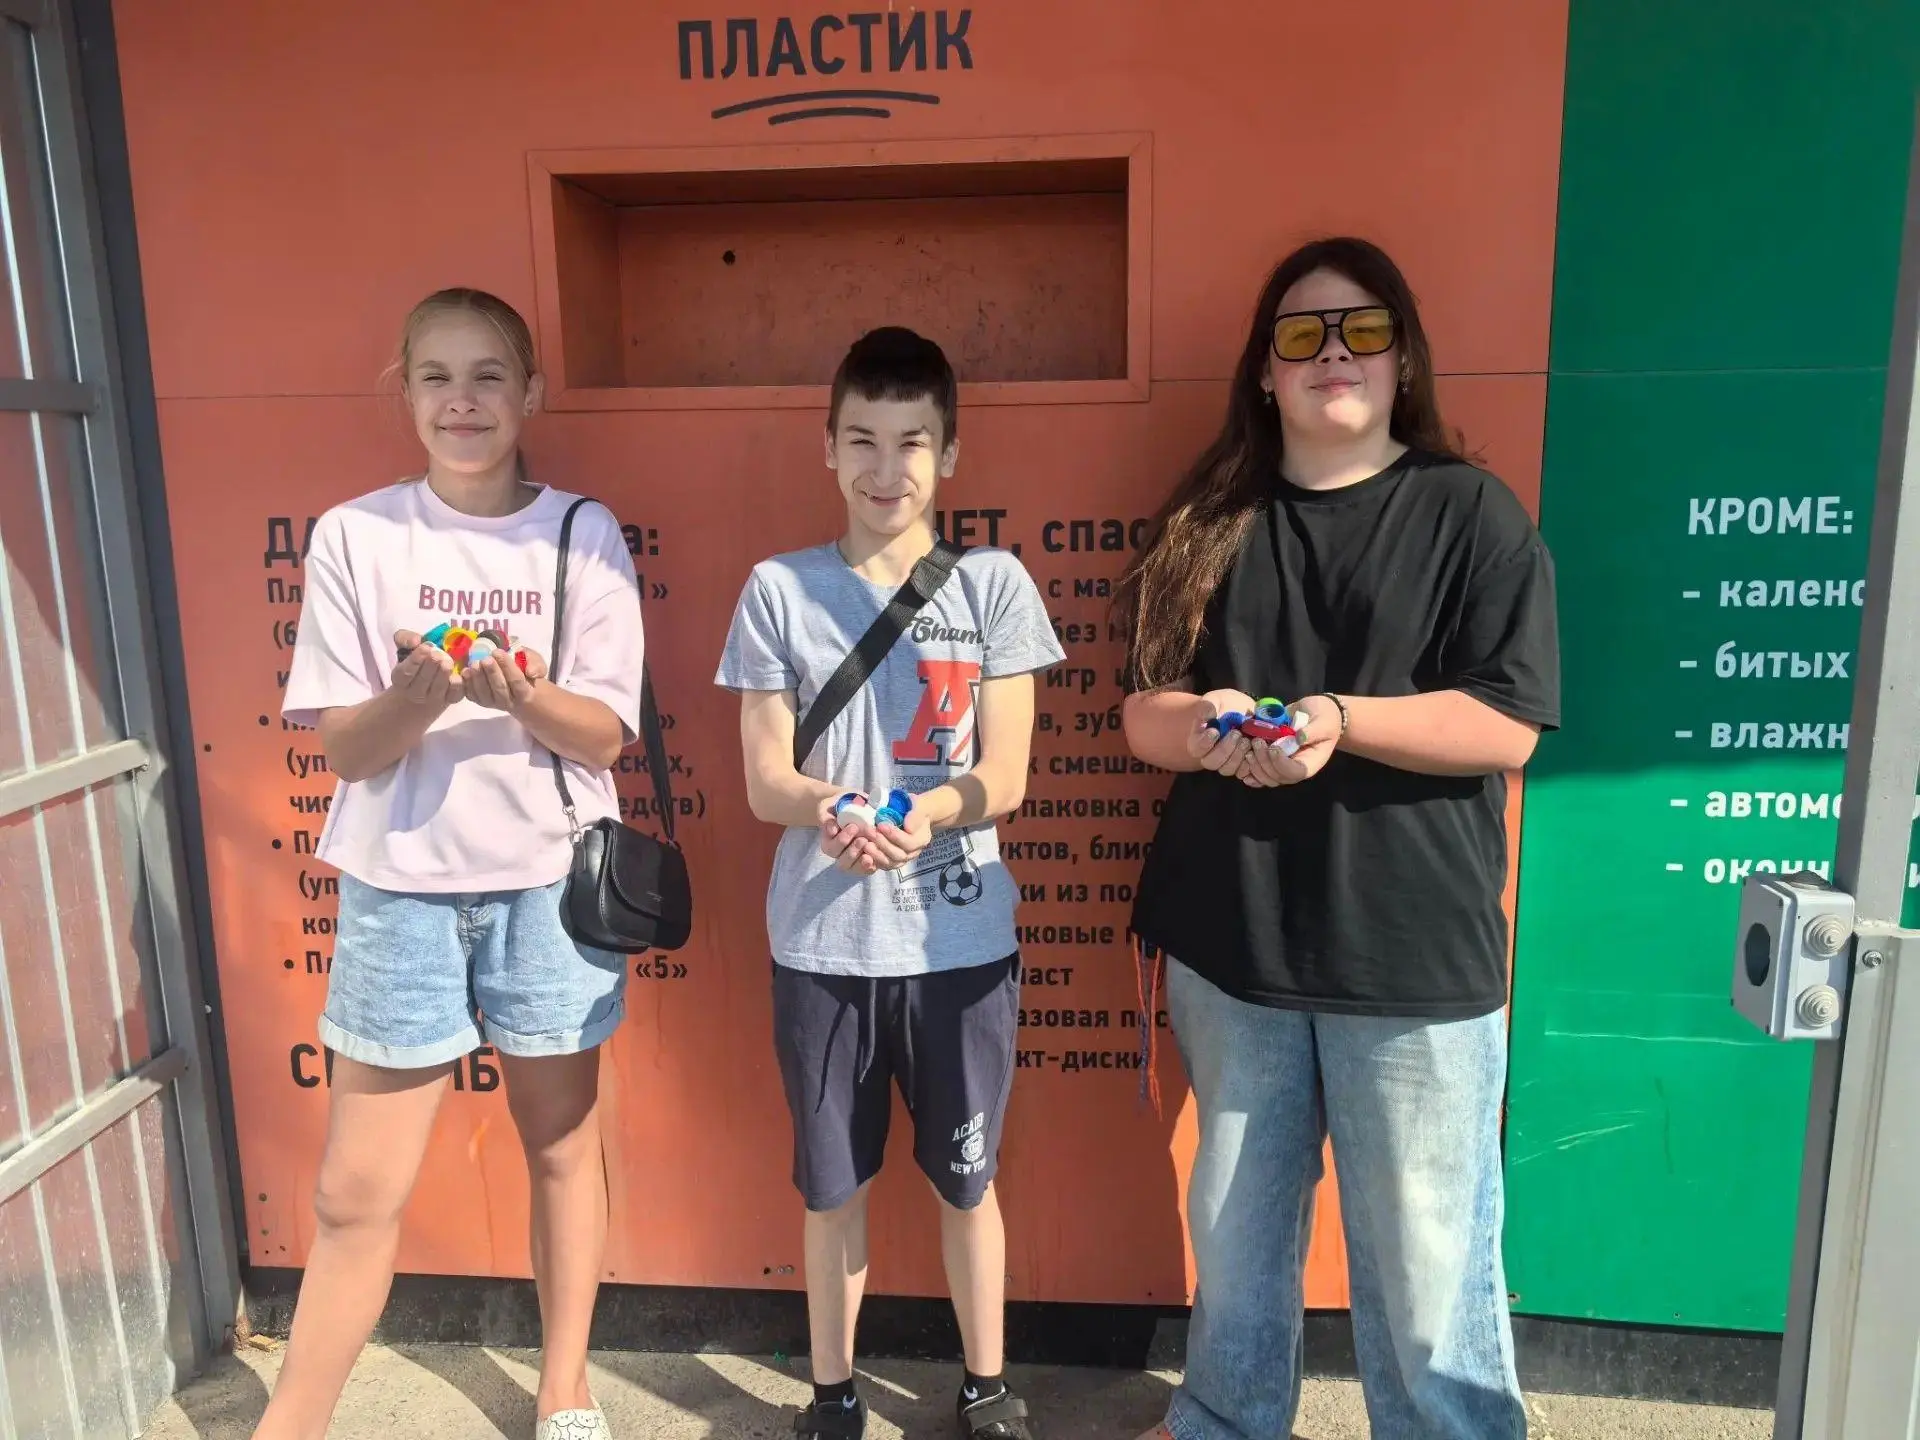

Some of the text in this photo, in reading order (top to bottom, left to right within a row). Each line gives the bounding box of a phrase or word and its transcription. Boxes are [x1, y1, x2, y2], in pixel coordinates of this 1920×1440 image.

[677, 9, 973, 80] ПЛАСТИК
[1688, 496, 1854, 535] КРОМЕ:
[418, 584, 542, 615] BONJOUR
[1715, 640, 1850, 679] битых
[892, 660, 981, 766] A
[1710, 722, 1849, 749] влажн
[286, 746, 333, 779] (уп
[1057, 884, 1088, 902] из
[1100, 884, 1136, 902] по
[303, 917, 337, 935] ко
[636, 955, 687, 979] «5»
